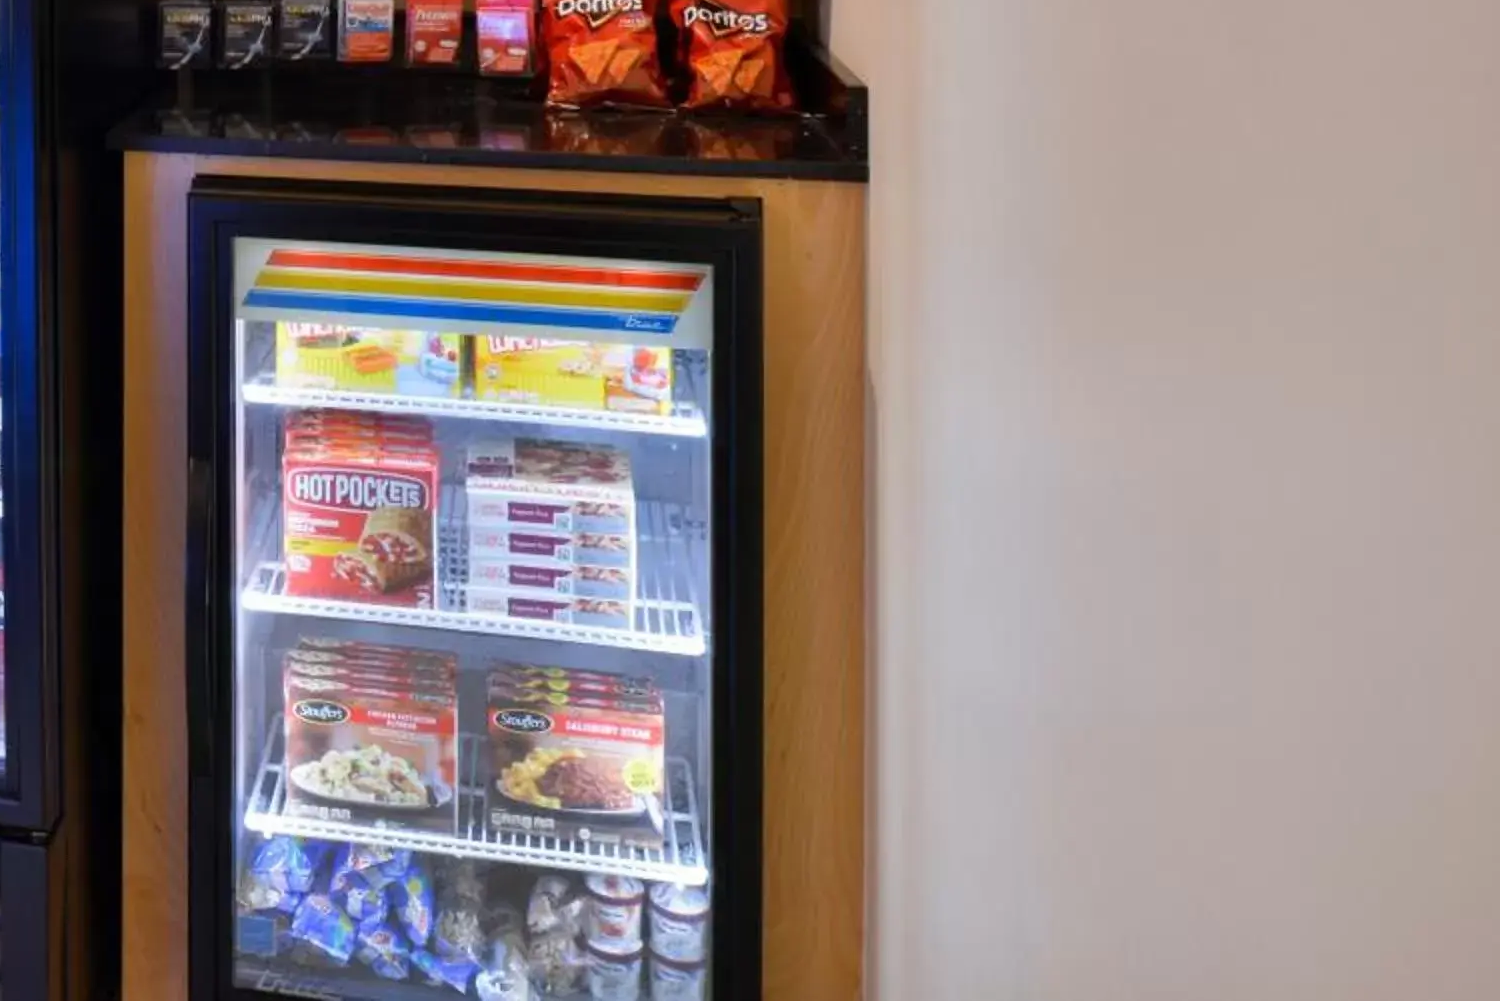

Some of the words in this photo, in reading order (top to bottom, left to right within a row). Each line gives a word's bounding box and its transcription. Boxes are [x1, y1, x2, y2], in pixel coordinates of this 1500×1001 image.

[683, 7, 769, 31] Doritos
[294, 473, 335, 504] HOT
[336, 475, 422, 508] POCKETS
[500, 713, 546, 730] Stouffer's
